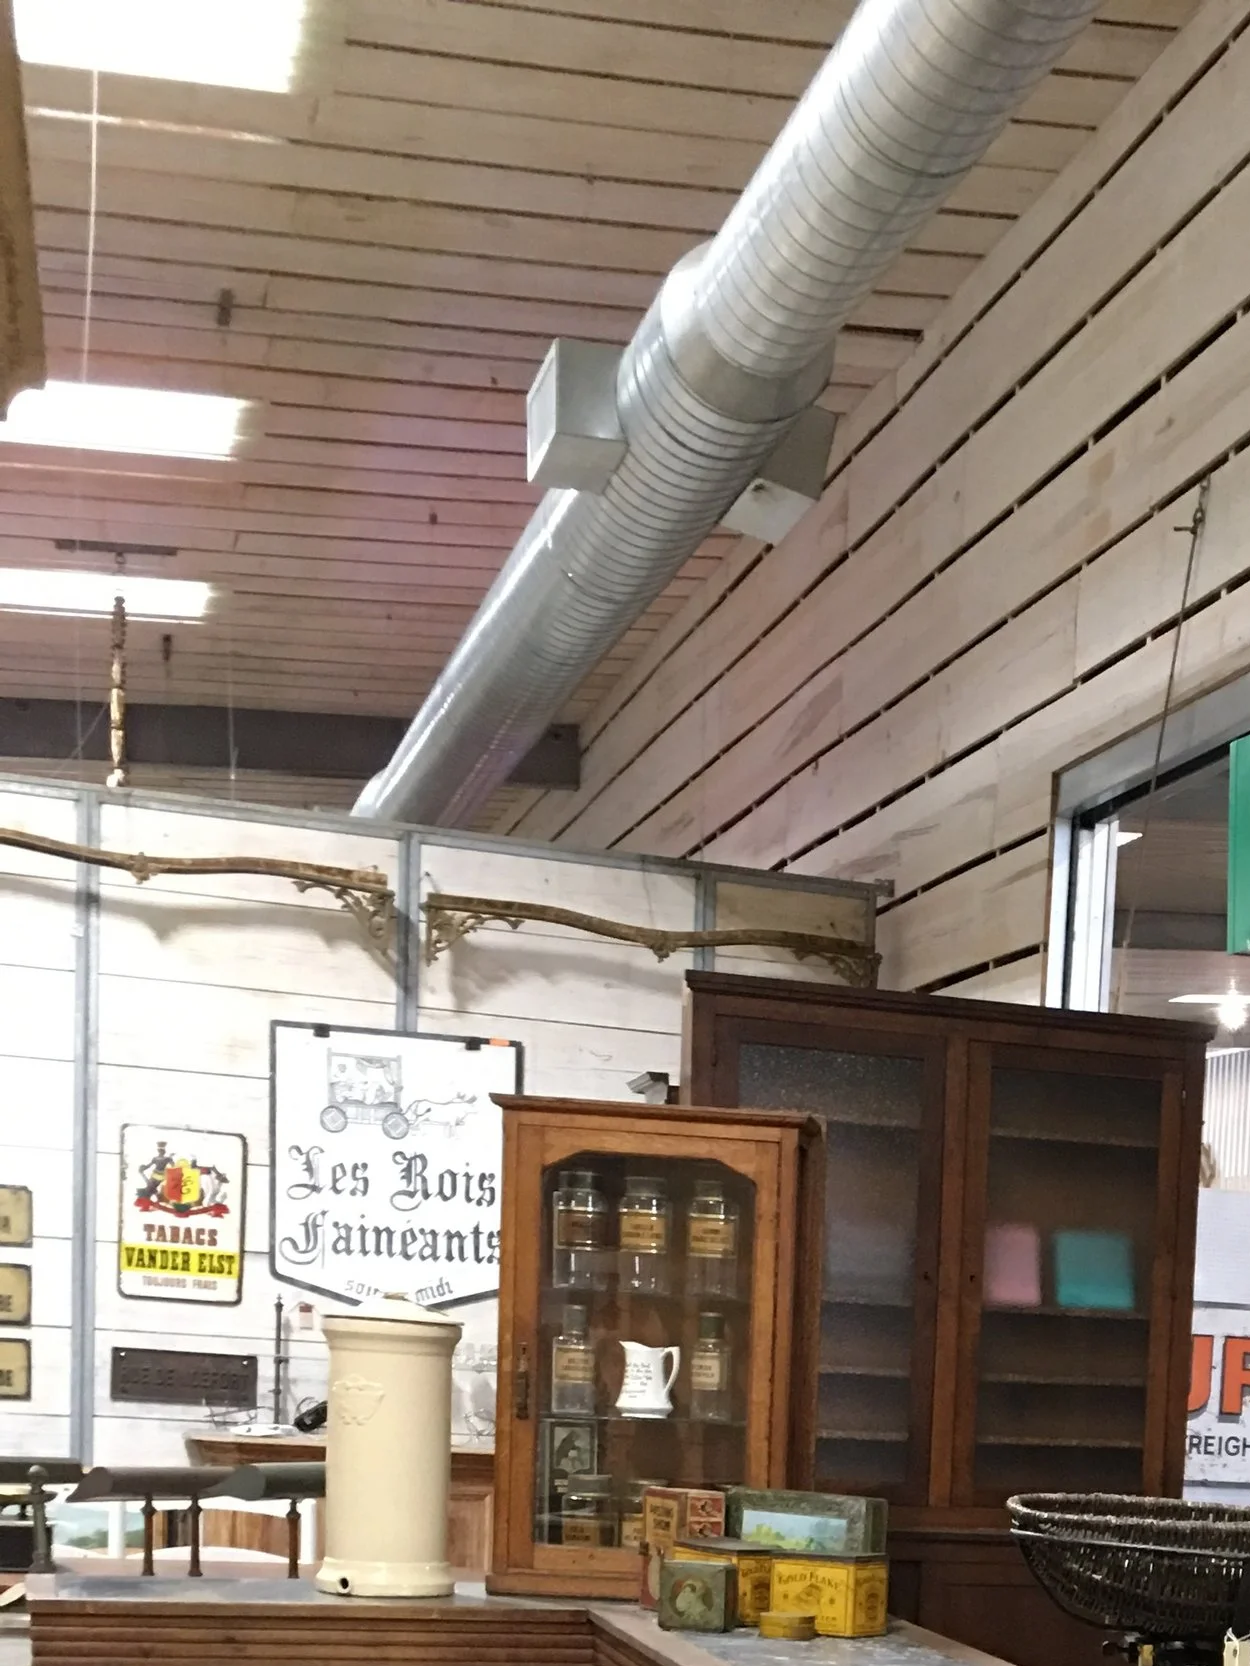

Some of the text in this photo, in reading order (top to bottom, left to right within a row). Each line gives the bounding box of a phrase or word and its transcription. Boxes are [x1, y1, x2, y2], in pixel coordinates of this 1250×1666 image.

[389, 1151, 496, 1211] Rois
[143, 1224, 218, 1247] TABACS
[125, 1247, 235, 1275] VANDER ELST
